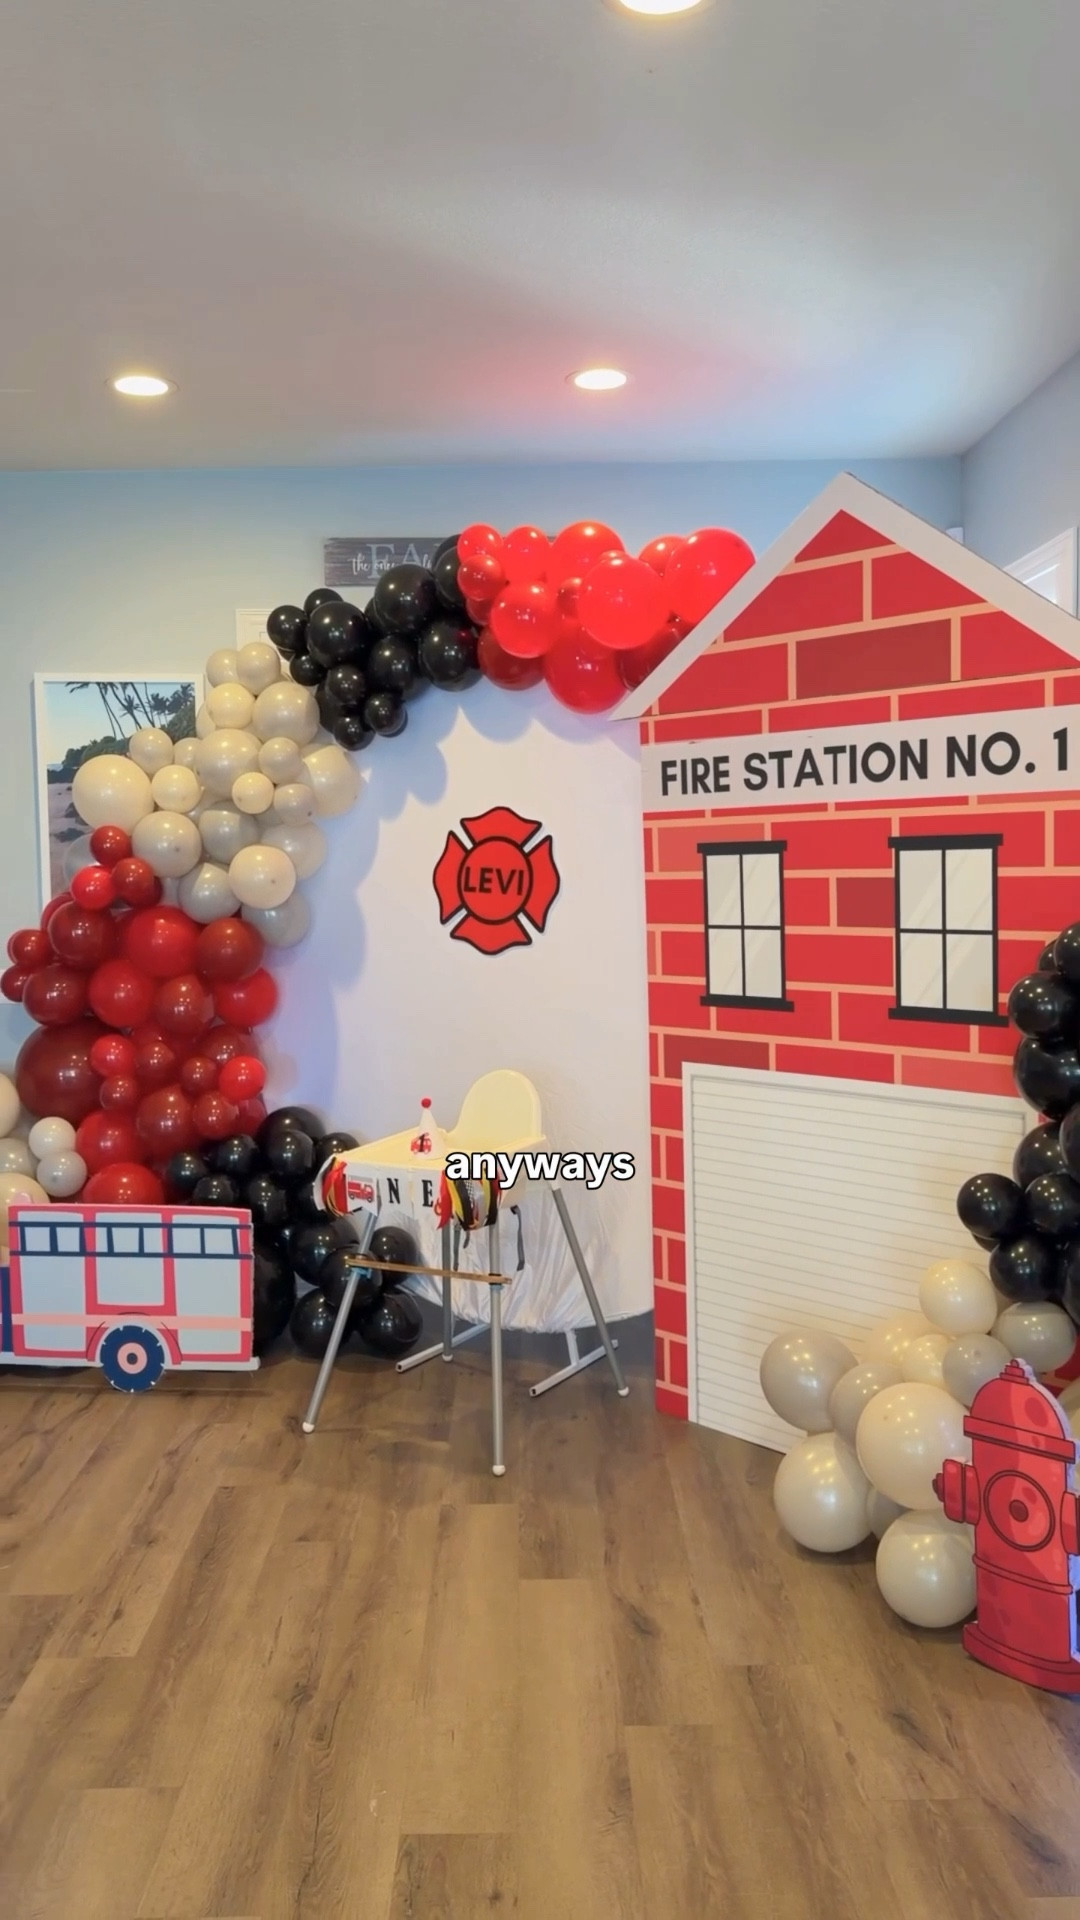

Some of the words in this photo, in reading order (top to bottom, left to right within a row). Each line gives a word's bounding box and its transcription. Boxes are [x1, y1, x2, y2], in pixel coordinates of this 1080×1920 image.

[347, 553, 371, 575] the
[661, 755, 731, 796] FIRE
[743, 738, 928, 792] STATION
[946, 731, 1036, 778] NO.
[1053, 727, 1068, 771] 1
[463, 866, 524, 896] LEVI
